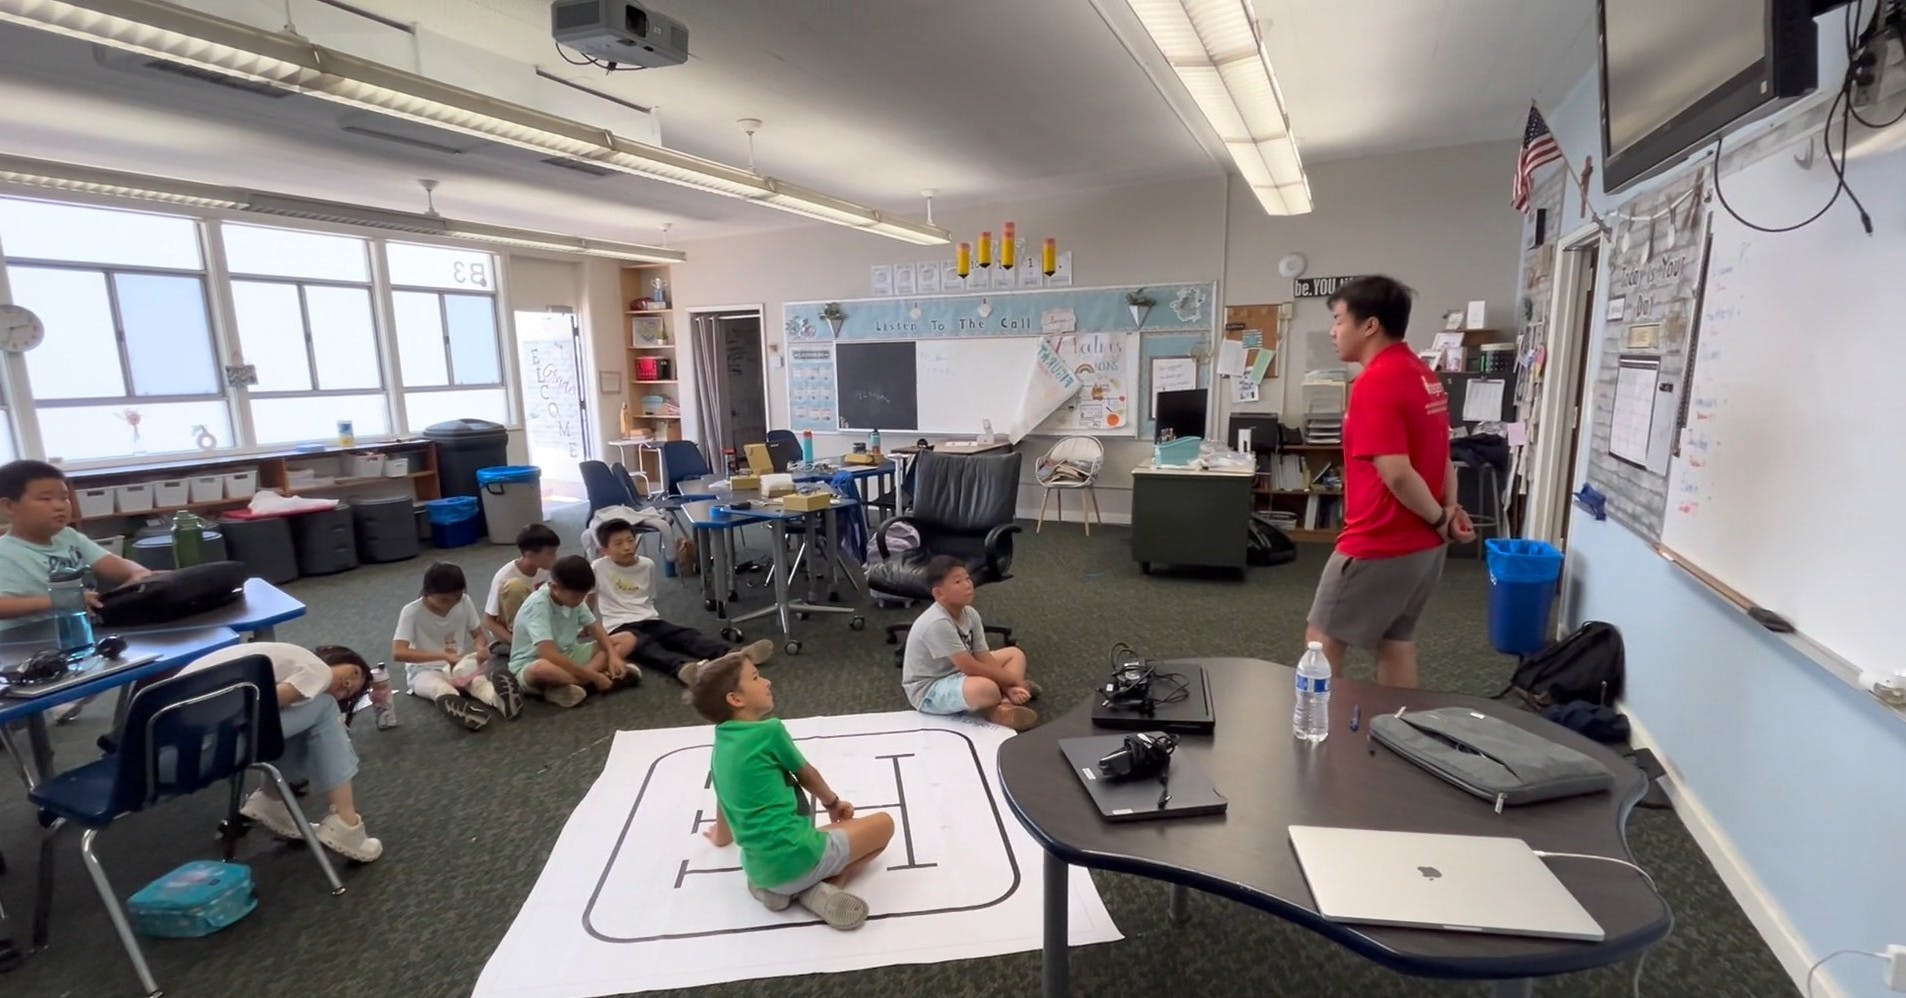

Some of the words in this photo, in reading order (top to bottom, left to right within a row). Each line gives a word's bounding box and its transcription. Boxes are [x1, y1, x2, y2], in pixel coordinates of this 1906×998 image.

[876, 320, 917, 332] Listen
[930, 319, 945, 332] To
[959, 318, 985, 330] The
[1001, 317, 1031, 329] Call
